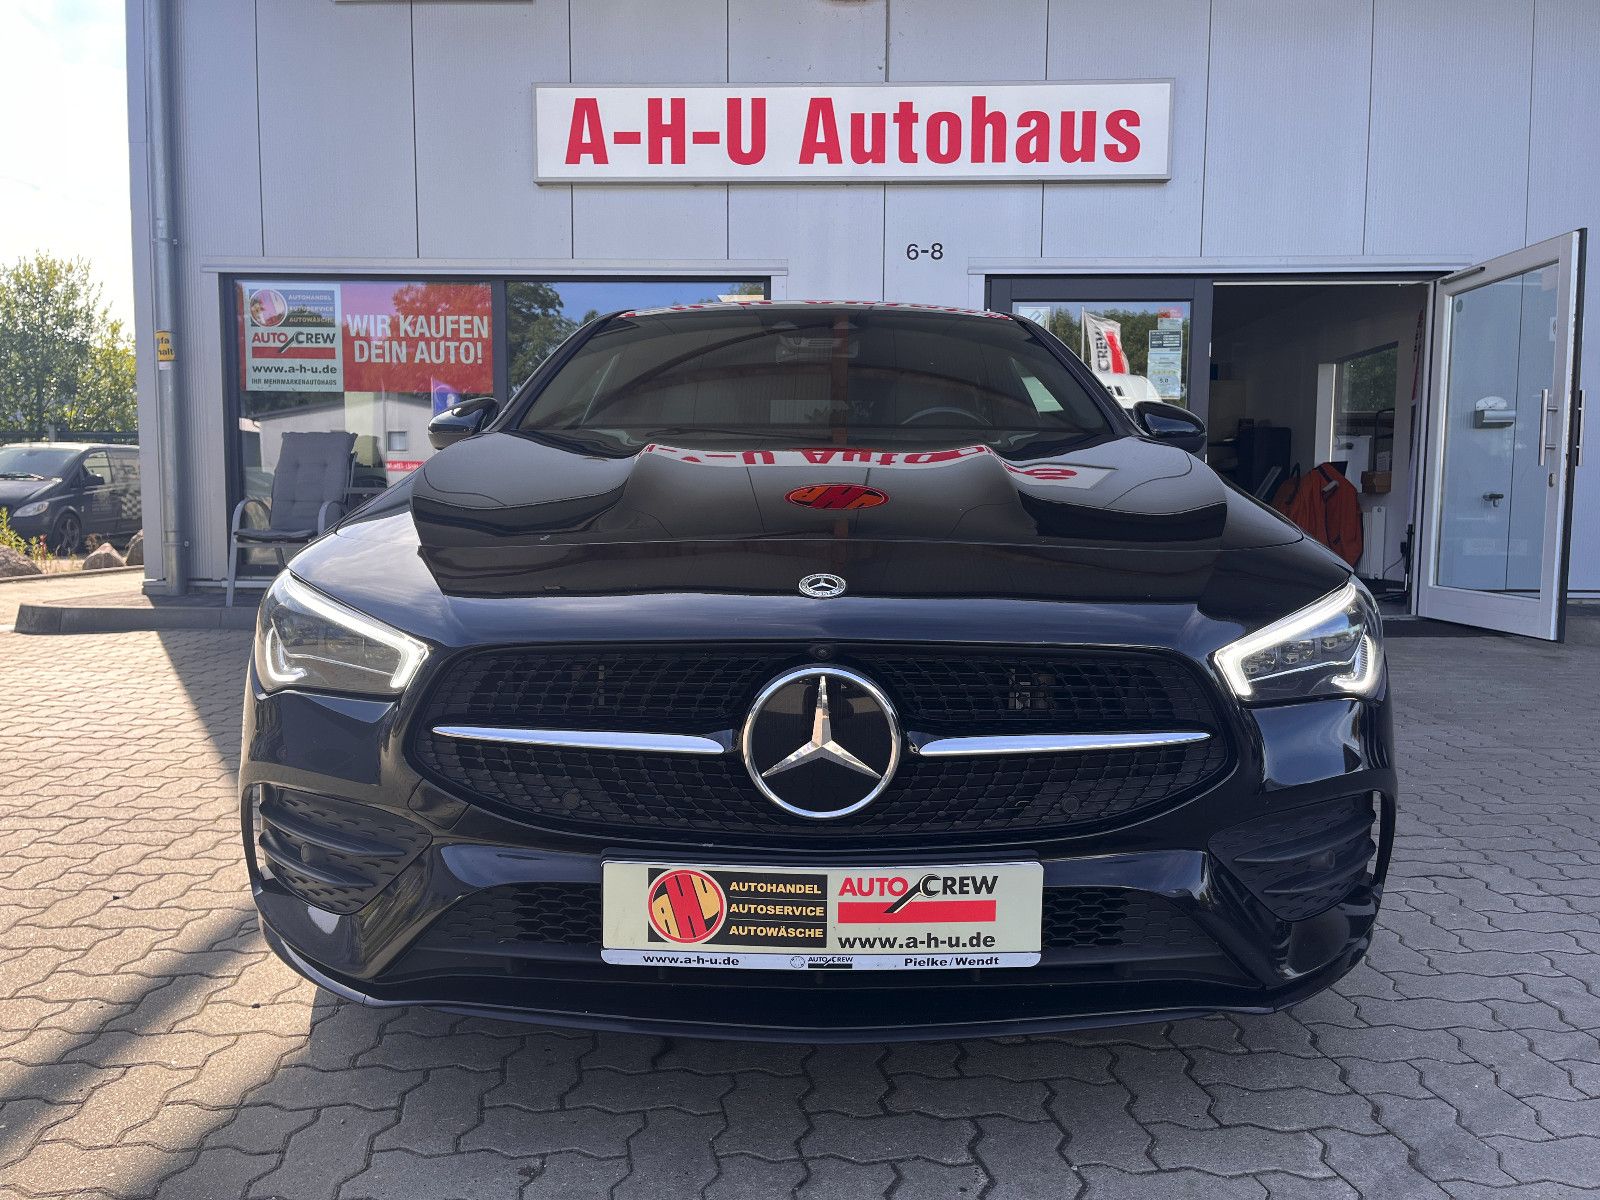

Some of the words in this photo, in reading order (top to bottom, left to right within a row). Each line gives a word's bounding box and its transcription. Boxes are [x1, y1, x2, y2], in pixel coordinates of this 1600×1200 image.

[565, 97, 767, 166] A-H-U
[798, 95, 1141, 165] Autohaus
[906, 242, 944, 261] 6-8
[345, 314, 391, 338] WIR
[399, 315, 489, 339] KAUFEN
[354, 340, 407, 364] DEIN
[413, 341, 483, 365] AUTO!
[252, 364, 337, 374] www.a-h-u.de
[729, 881, 822, 894] AUTOHANDEL
[729, 903, 825, 916] AUTOSERVICE
[729, 925, 824, 938] AUTOWÄSCHE
[837, 931, 996, 949] www.a-h-u.de
[642, 955, 740, 966] www.a-h-u.de
